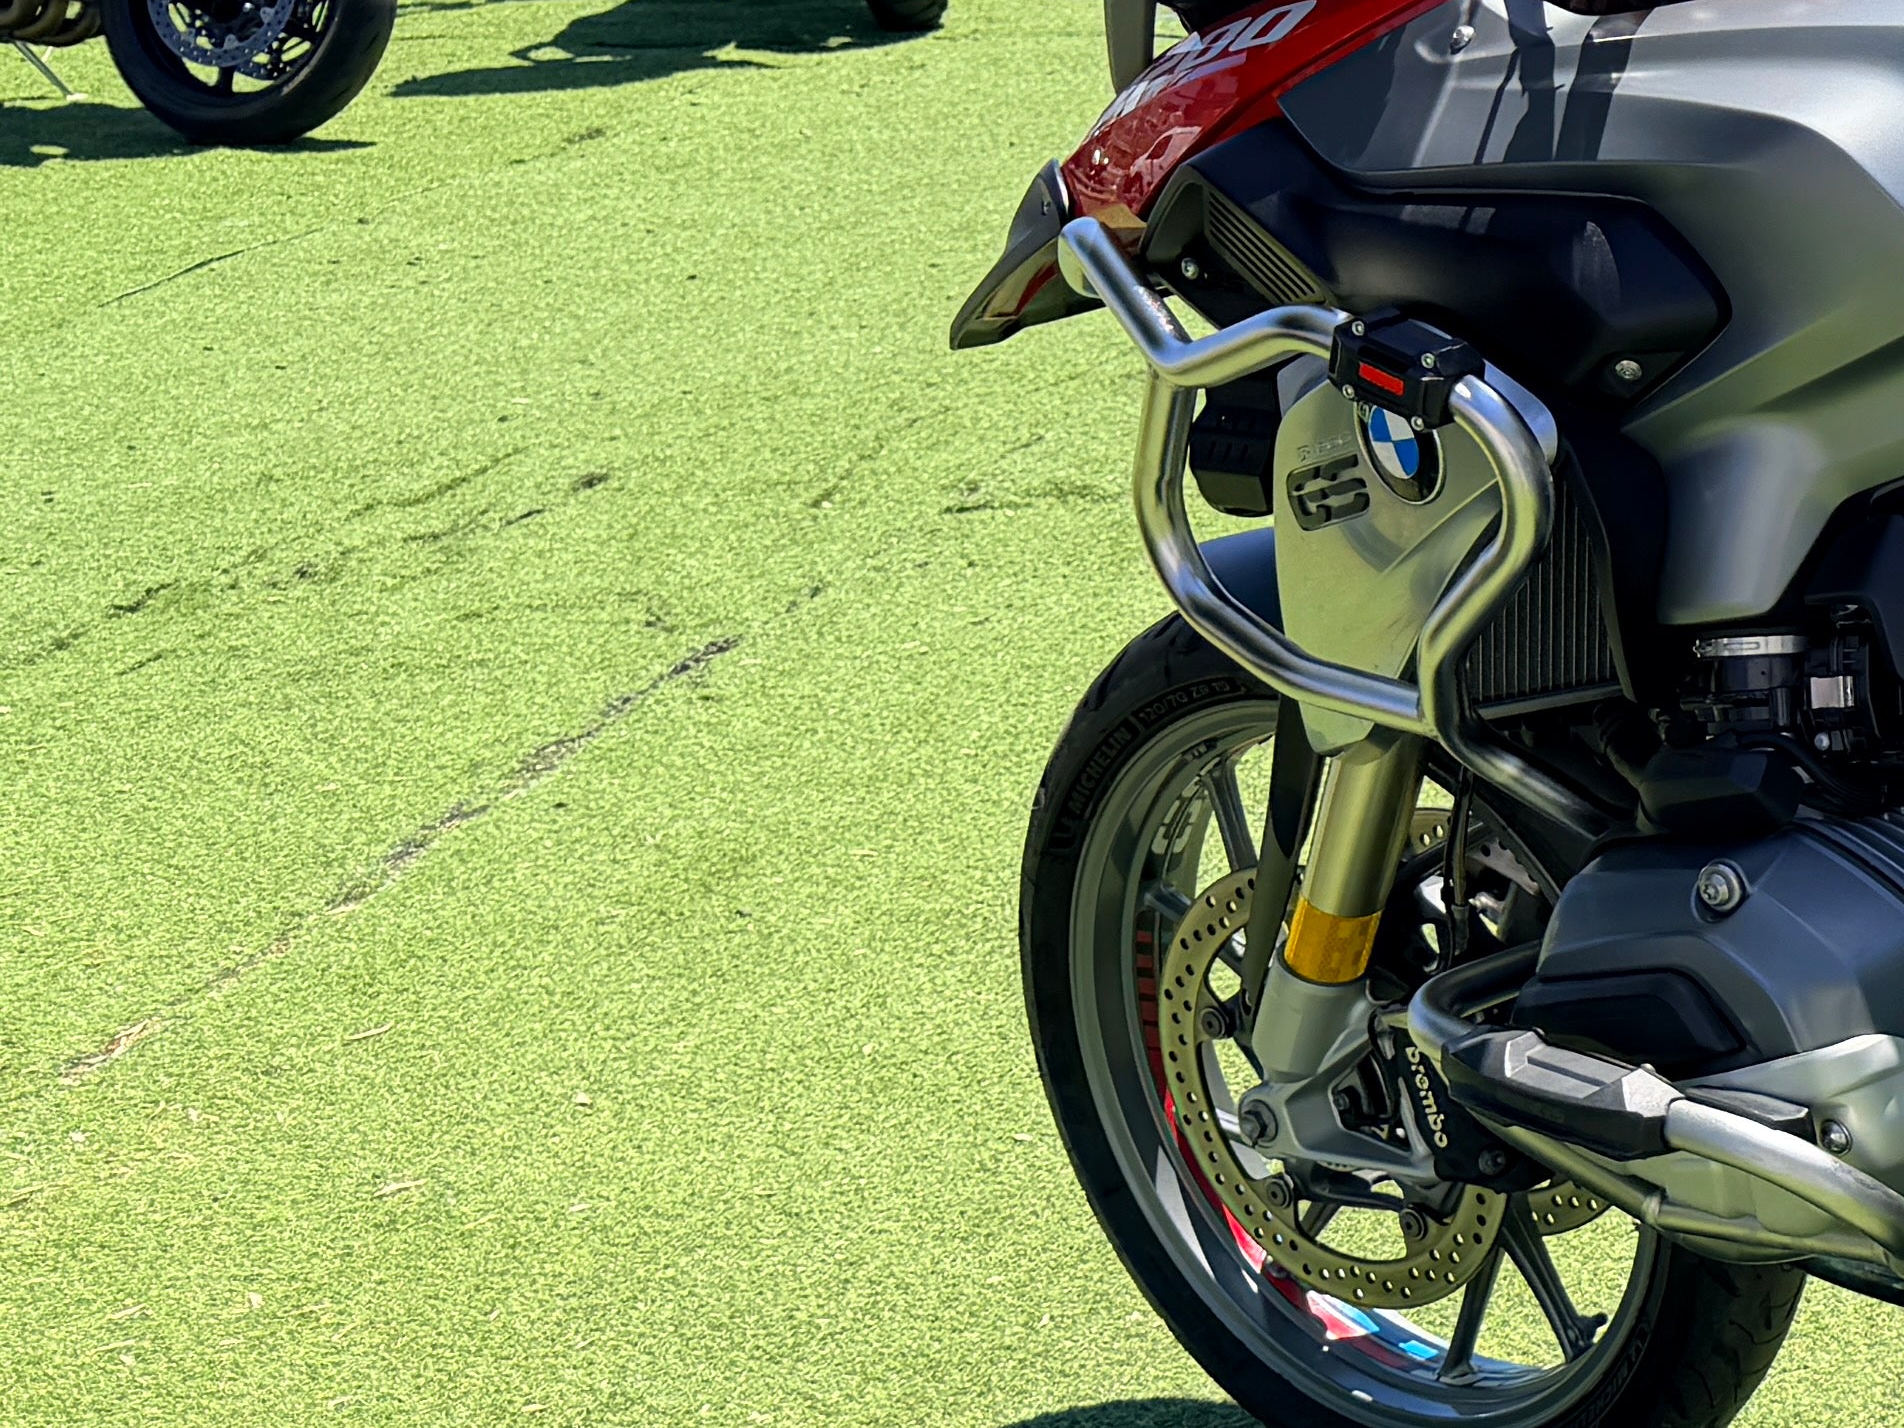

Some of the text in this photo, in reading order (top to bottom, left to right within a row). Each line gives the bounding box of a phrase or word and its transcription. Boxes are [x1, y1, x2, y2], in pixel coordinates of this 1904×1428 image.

[1285, 453, 1371, 532] GS
[1067, 726, 1133, 816] MICHELIN
[1404, 1045, 1449, 1149] brembo
